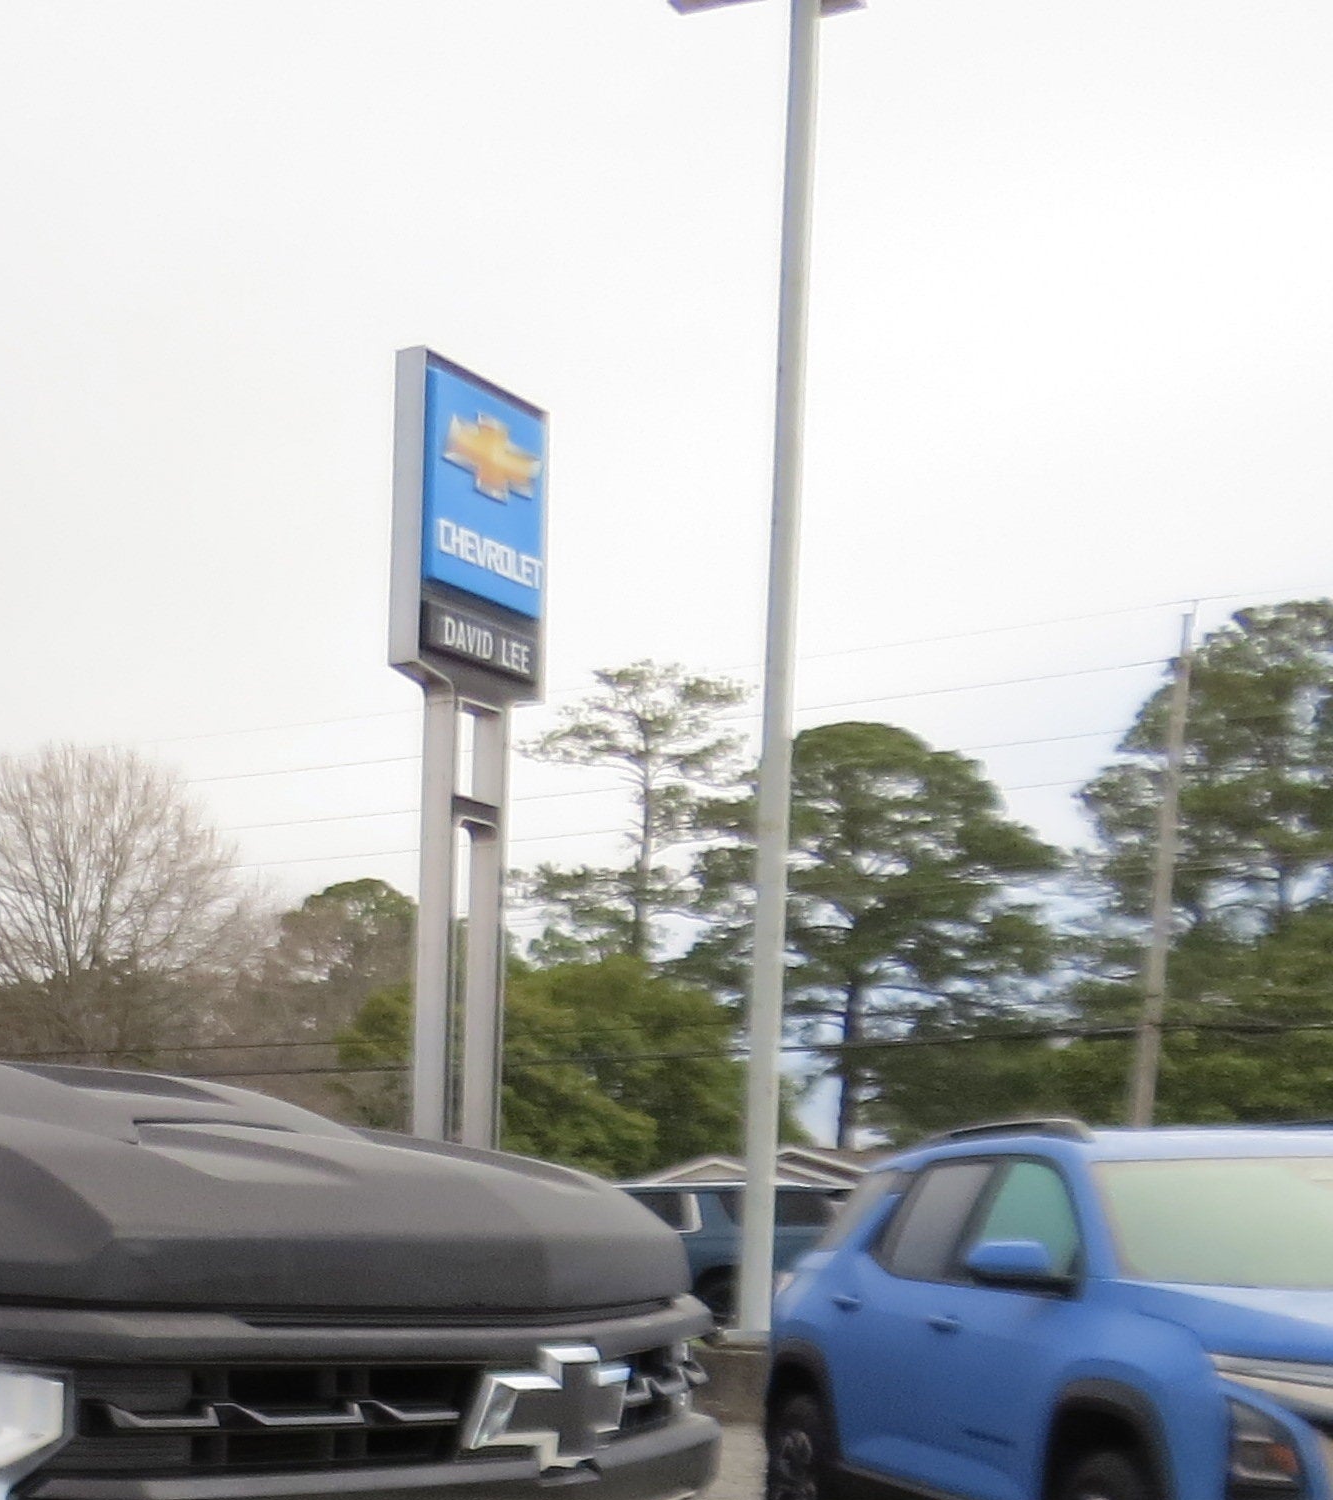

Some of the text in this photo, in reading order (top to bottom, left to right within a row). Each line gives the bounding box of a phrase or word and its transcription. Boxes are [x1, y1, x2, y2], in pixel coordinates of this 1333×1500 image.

[436, 517, 543, 590] CHEVROLET
[443, 616, 531, 675] DAVID LEE
